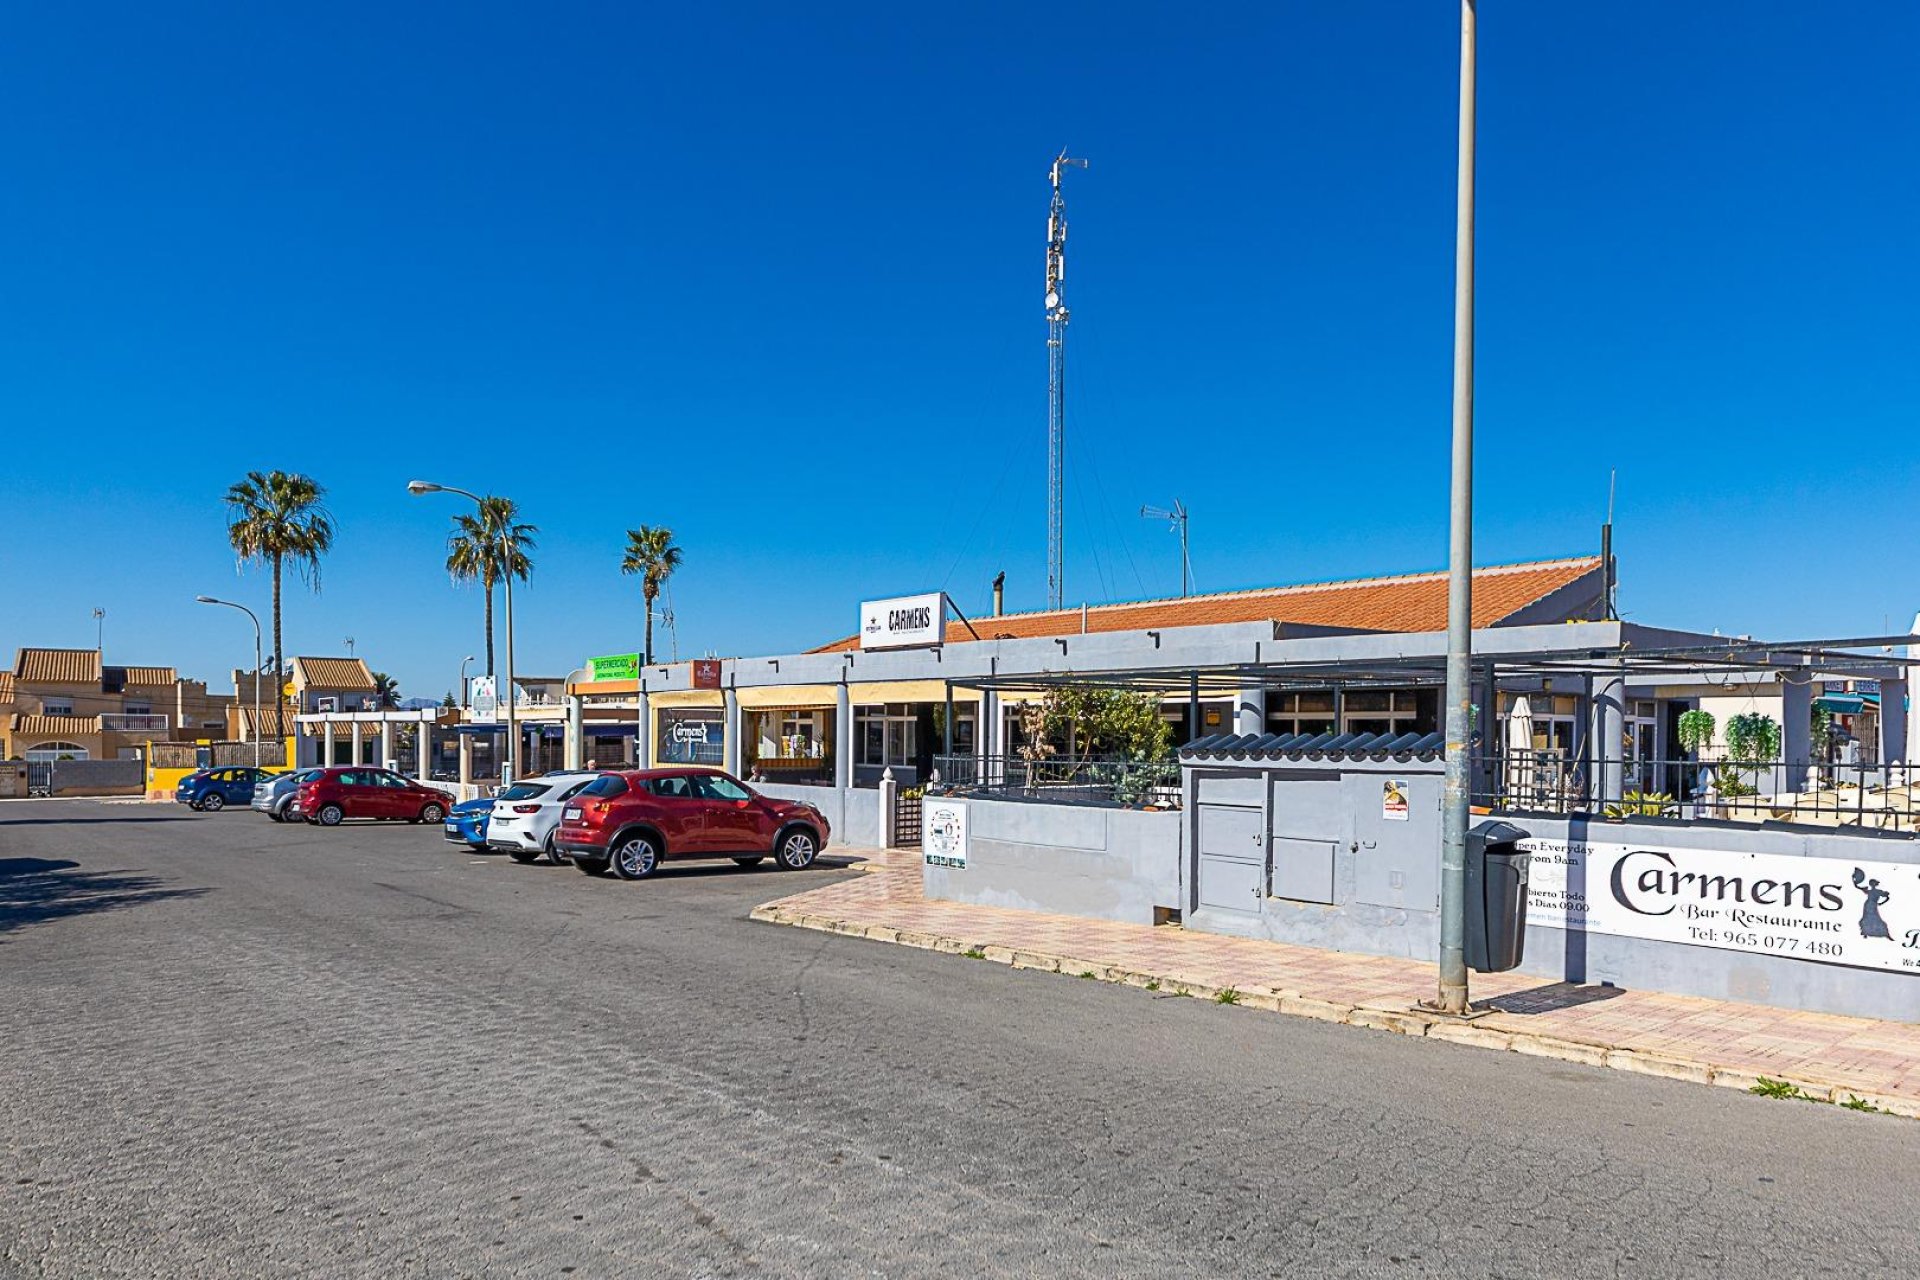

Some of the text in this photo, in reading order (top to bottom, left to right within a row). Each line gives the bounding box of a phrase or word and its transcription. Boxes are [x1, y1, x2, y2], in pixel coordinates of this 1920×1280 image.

[889, 606, 930, 631] CARMENS
[1540, 842, 1594, 856] Everyday
[1554, 855, 1579, 866] 9am
[1610, 851, 1843, 915] Carmens
[1560, 890, 1586, 901] Todo
[1560, 901, 1590, 912] 09.00
[1680, 904, 1842, 932] Bar Restaurante
[1688, 926, 1843, 956] Tel: 965 077 480
